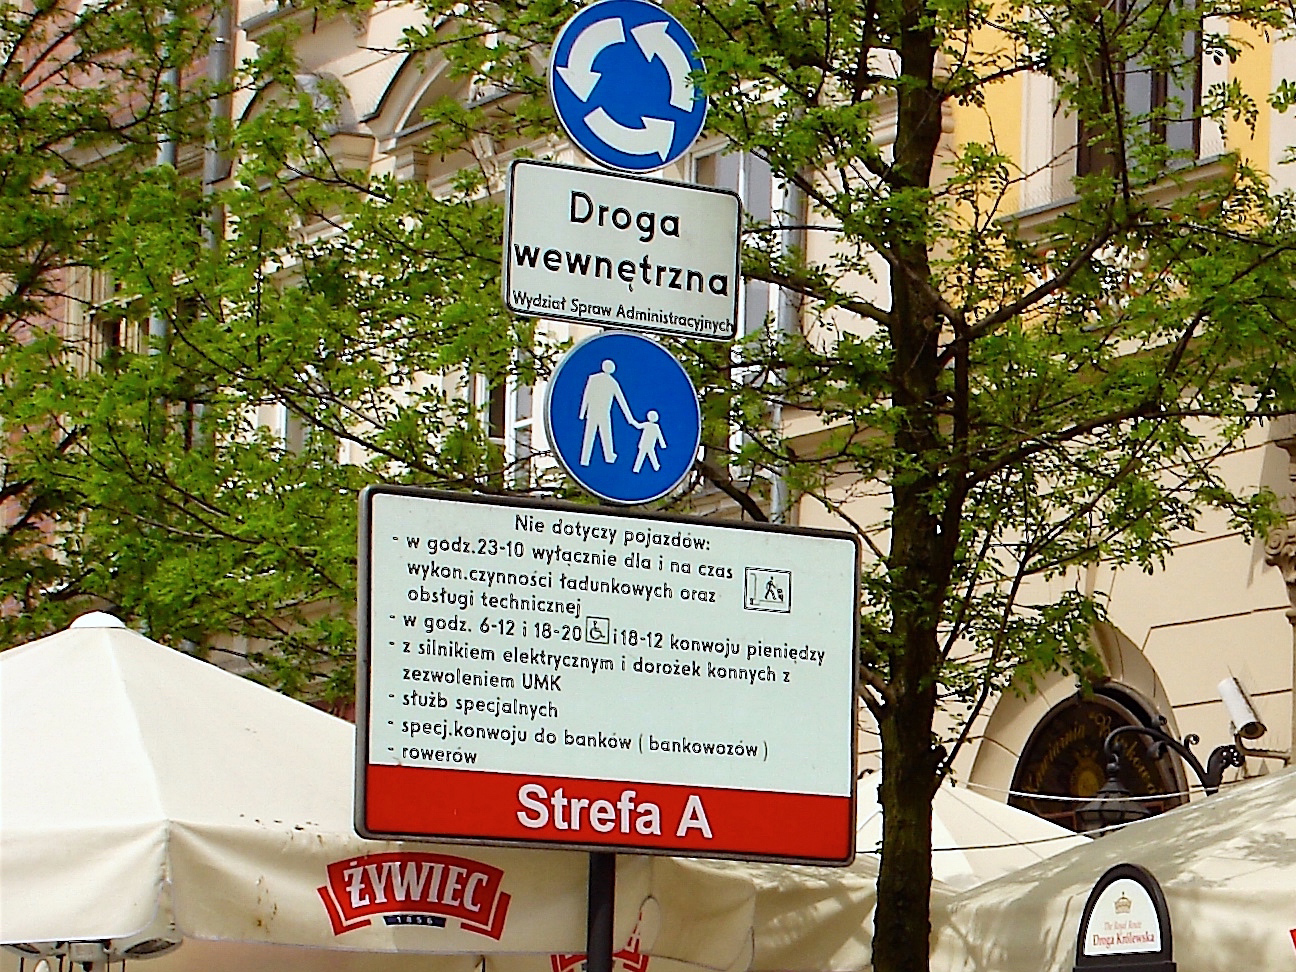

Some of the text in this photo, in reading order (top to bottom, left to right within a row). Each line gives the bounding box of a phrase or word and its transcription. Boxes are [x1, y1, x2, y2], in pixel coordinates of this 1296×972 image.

[569, 190, 680, 242] Droga
[513, 243, 728, 296] wewnętrzna
[512, 290, 734, 334] Wydział Spraw Administracyjnych
[515, 514, 710, 550] Nie dotyczy pojazdów:
[406, 536, 419, 548] w
[532, 545, 617, 566] wyłącznie
[624, 552, 651, 570] dla
[658, 555, 663, 571] i
[670, 560, 691, 574] na
[698, 565, 733, 579] czas
[407, 586, 581, 619] obsługi technicznej
[560, 573, 673, 601] ładunkowych
[680, 588, 716, 602] oraz
[403, 614, 417, 627] w
[424, 615, 472, 633] godz.
[479, 617, 515, 636] 6-12
[534, 622, 582, 641] 18-20
[670, 634, 740, 658] konwoju
[747, 641, 825, 666] pieniędzy
[402, 641, 411, 653] z
[418, 639, 495, 661] silnikiem
[503, 647, 615, 671] elektrycznym
[633, 657, 701, 677] dorożek
[707, 662, 776, 685] konnych
[783, 670, 791, 683] z
[402, 668, 562, 692] zezwoleniem UMK
[402, 690, 558, 721] służb specjalnych
[402, 746, 478, 764] rowerów
[534, 728, 557, 745] do
[564, 730, 632, 750] banków
[516, 784, 713, 839] Strefa A
[343, 860, 489, 913] ŻYWIEC
